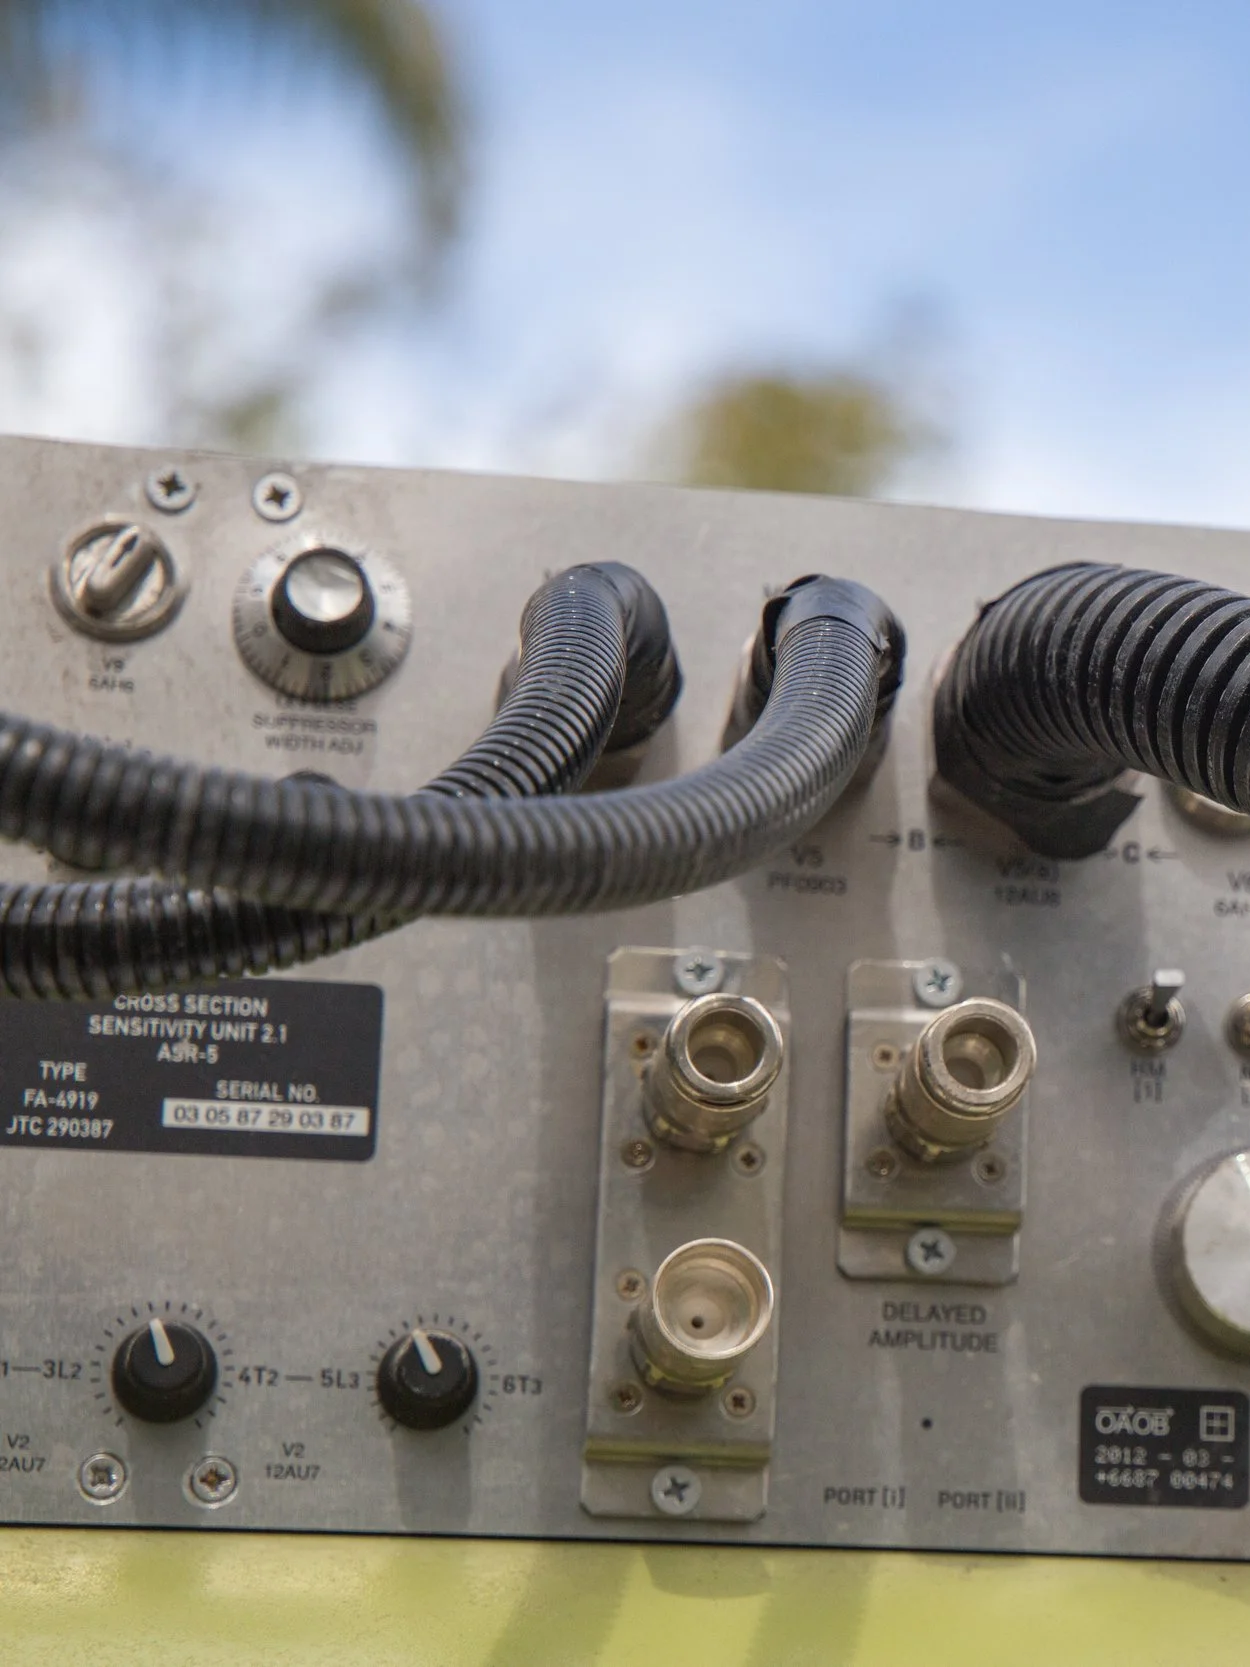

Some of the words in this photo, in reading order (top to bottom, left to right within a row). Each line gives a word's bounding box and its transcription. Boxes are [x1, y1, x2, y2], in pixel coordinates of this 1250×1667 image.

[252, 711, 378, 735] SUPPRESSOR
[264, 733, 325, 752] WIDTH
[328, 736, 364, 755] ADJ
[114, 993, 180, 1014] CROSS
[184, 994, 269, 1017] SECTION
[88, 1014, 208, 1039] SENSITIVITY
[211, 1020, 259, 1042] UNIT
[261, 1022, 287, 1044] 2.1
[157, 1041, 220, 1064] ASR-5
[40, 1060, 87, 1082] TYPE
[24, 1088, 99, 1110] FA-4919
[215, 1079, 285, 1102] SERIAL
[288, 1083, 321, 1104] NO.
[6, 1116, 42, 1136] JTC
[47, 1118, 113, 1139] 290387
[173, 1105, 199, 1124] 03
[205, 1106, 231, 1125] 05
[237, 1107, 262, 1127] 87
[268, 1108, 294, 1128] 29
[300, 1110, 325, 1130] 03
[330, 1111, 356, 1131] 87
[882, 1301, 987, 1325] DELAYED
[868, 1329, 999, 1353] AMPLITUDE
[502, 1374, 543, 1396] 6T3
[7, 1433, 30, 1449] V2
[0, 1455, 46, 1473] 2AU7
[1095, 1445, 1148, 1466] 2012
[265, 1464, 320, 1481] 12AU7
[824, 1487, 877, 1507] PORT
[938, 1490, 992, 1510] PORT
